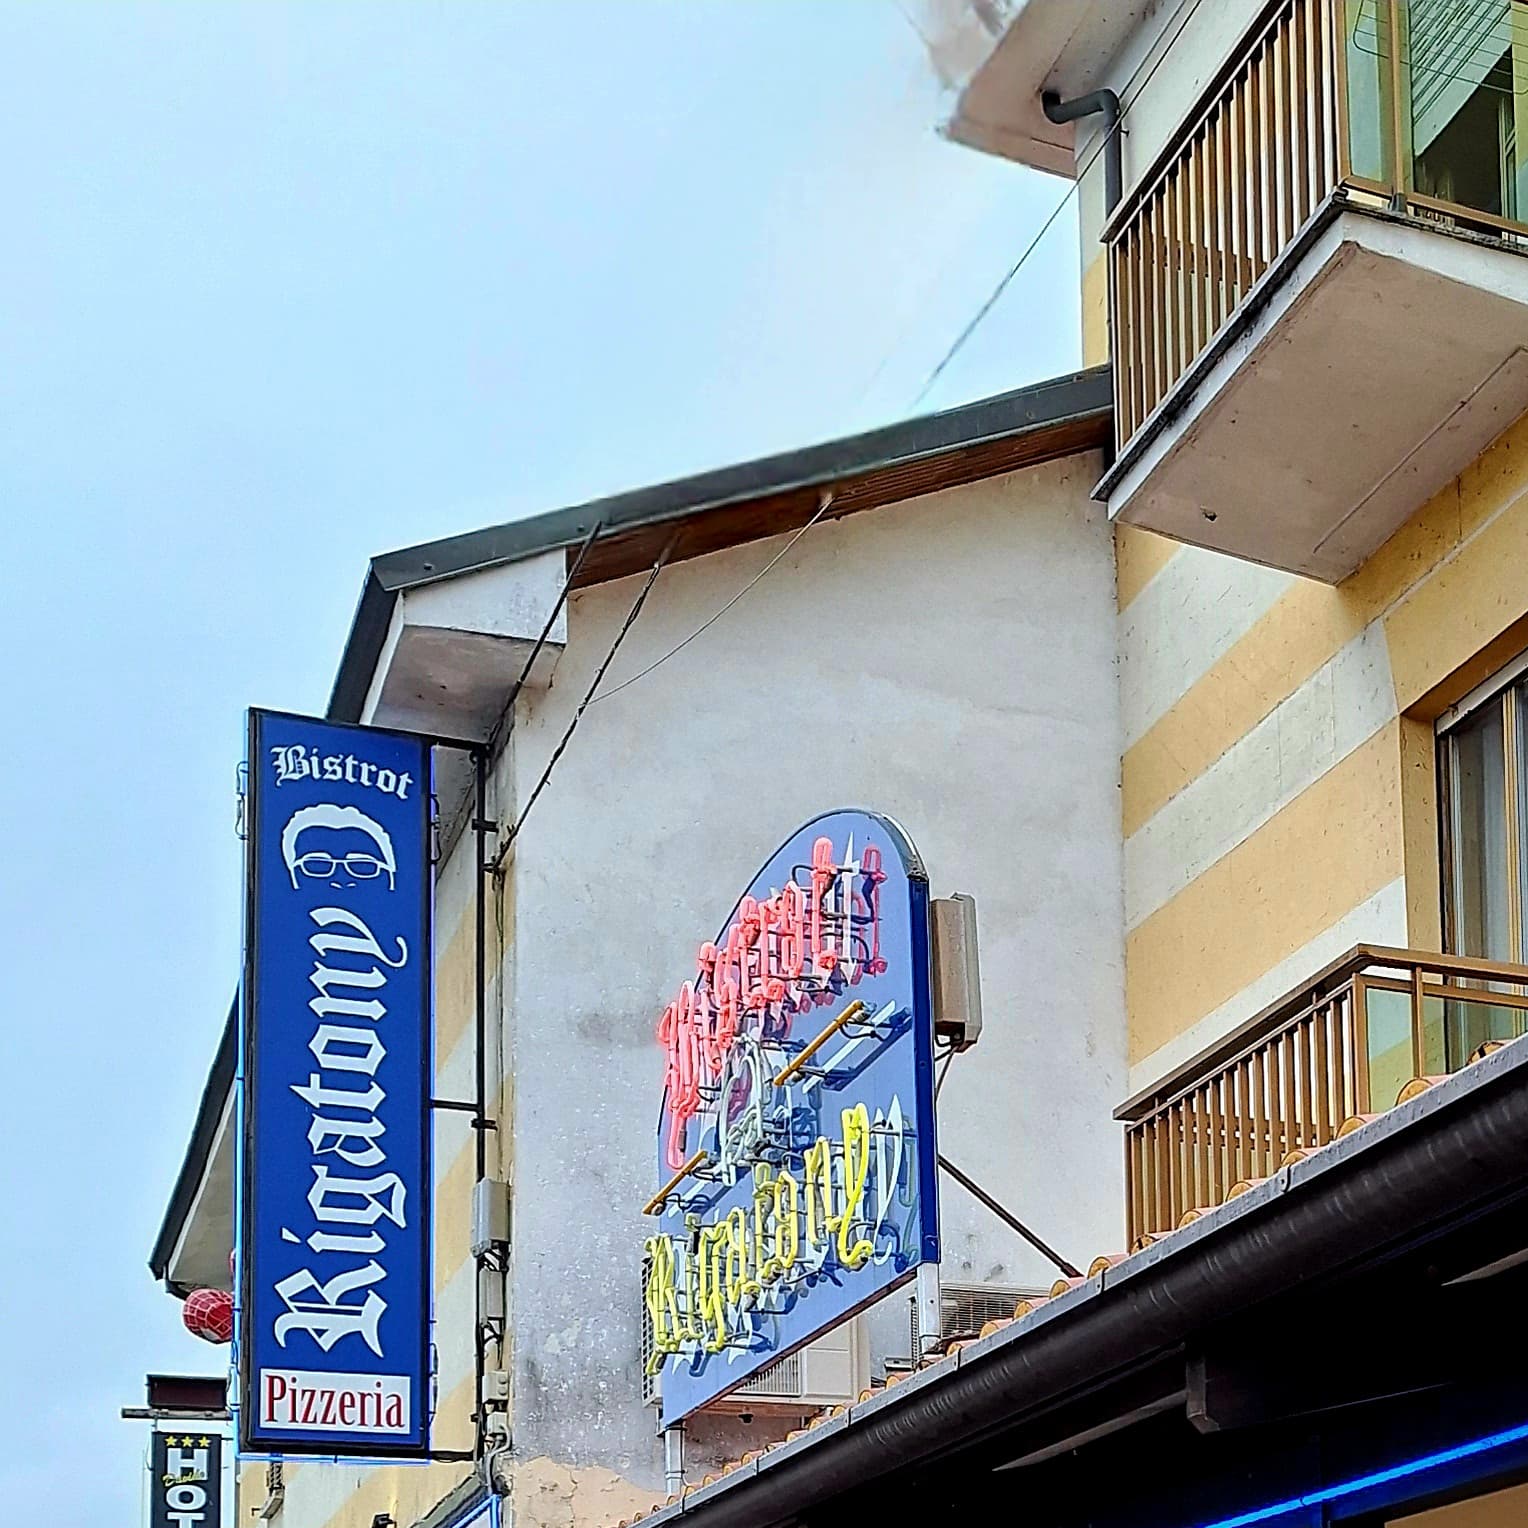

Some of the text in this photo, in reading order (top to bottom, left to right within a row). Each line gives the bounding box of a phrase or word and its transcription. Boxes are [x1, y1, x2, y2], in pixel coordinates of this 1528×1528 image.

[270, 745, 414, 800] Bistrot
[274, 906, 408, 1359] Rigatony
[265, 1374, 406, 1428] Pizzeria
